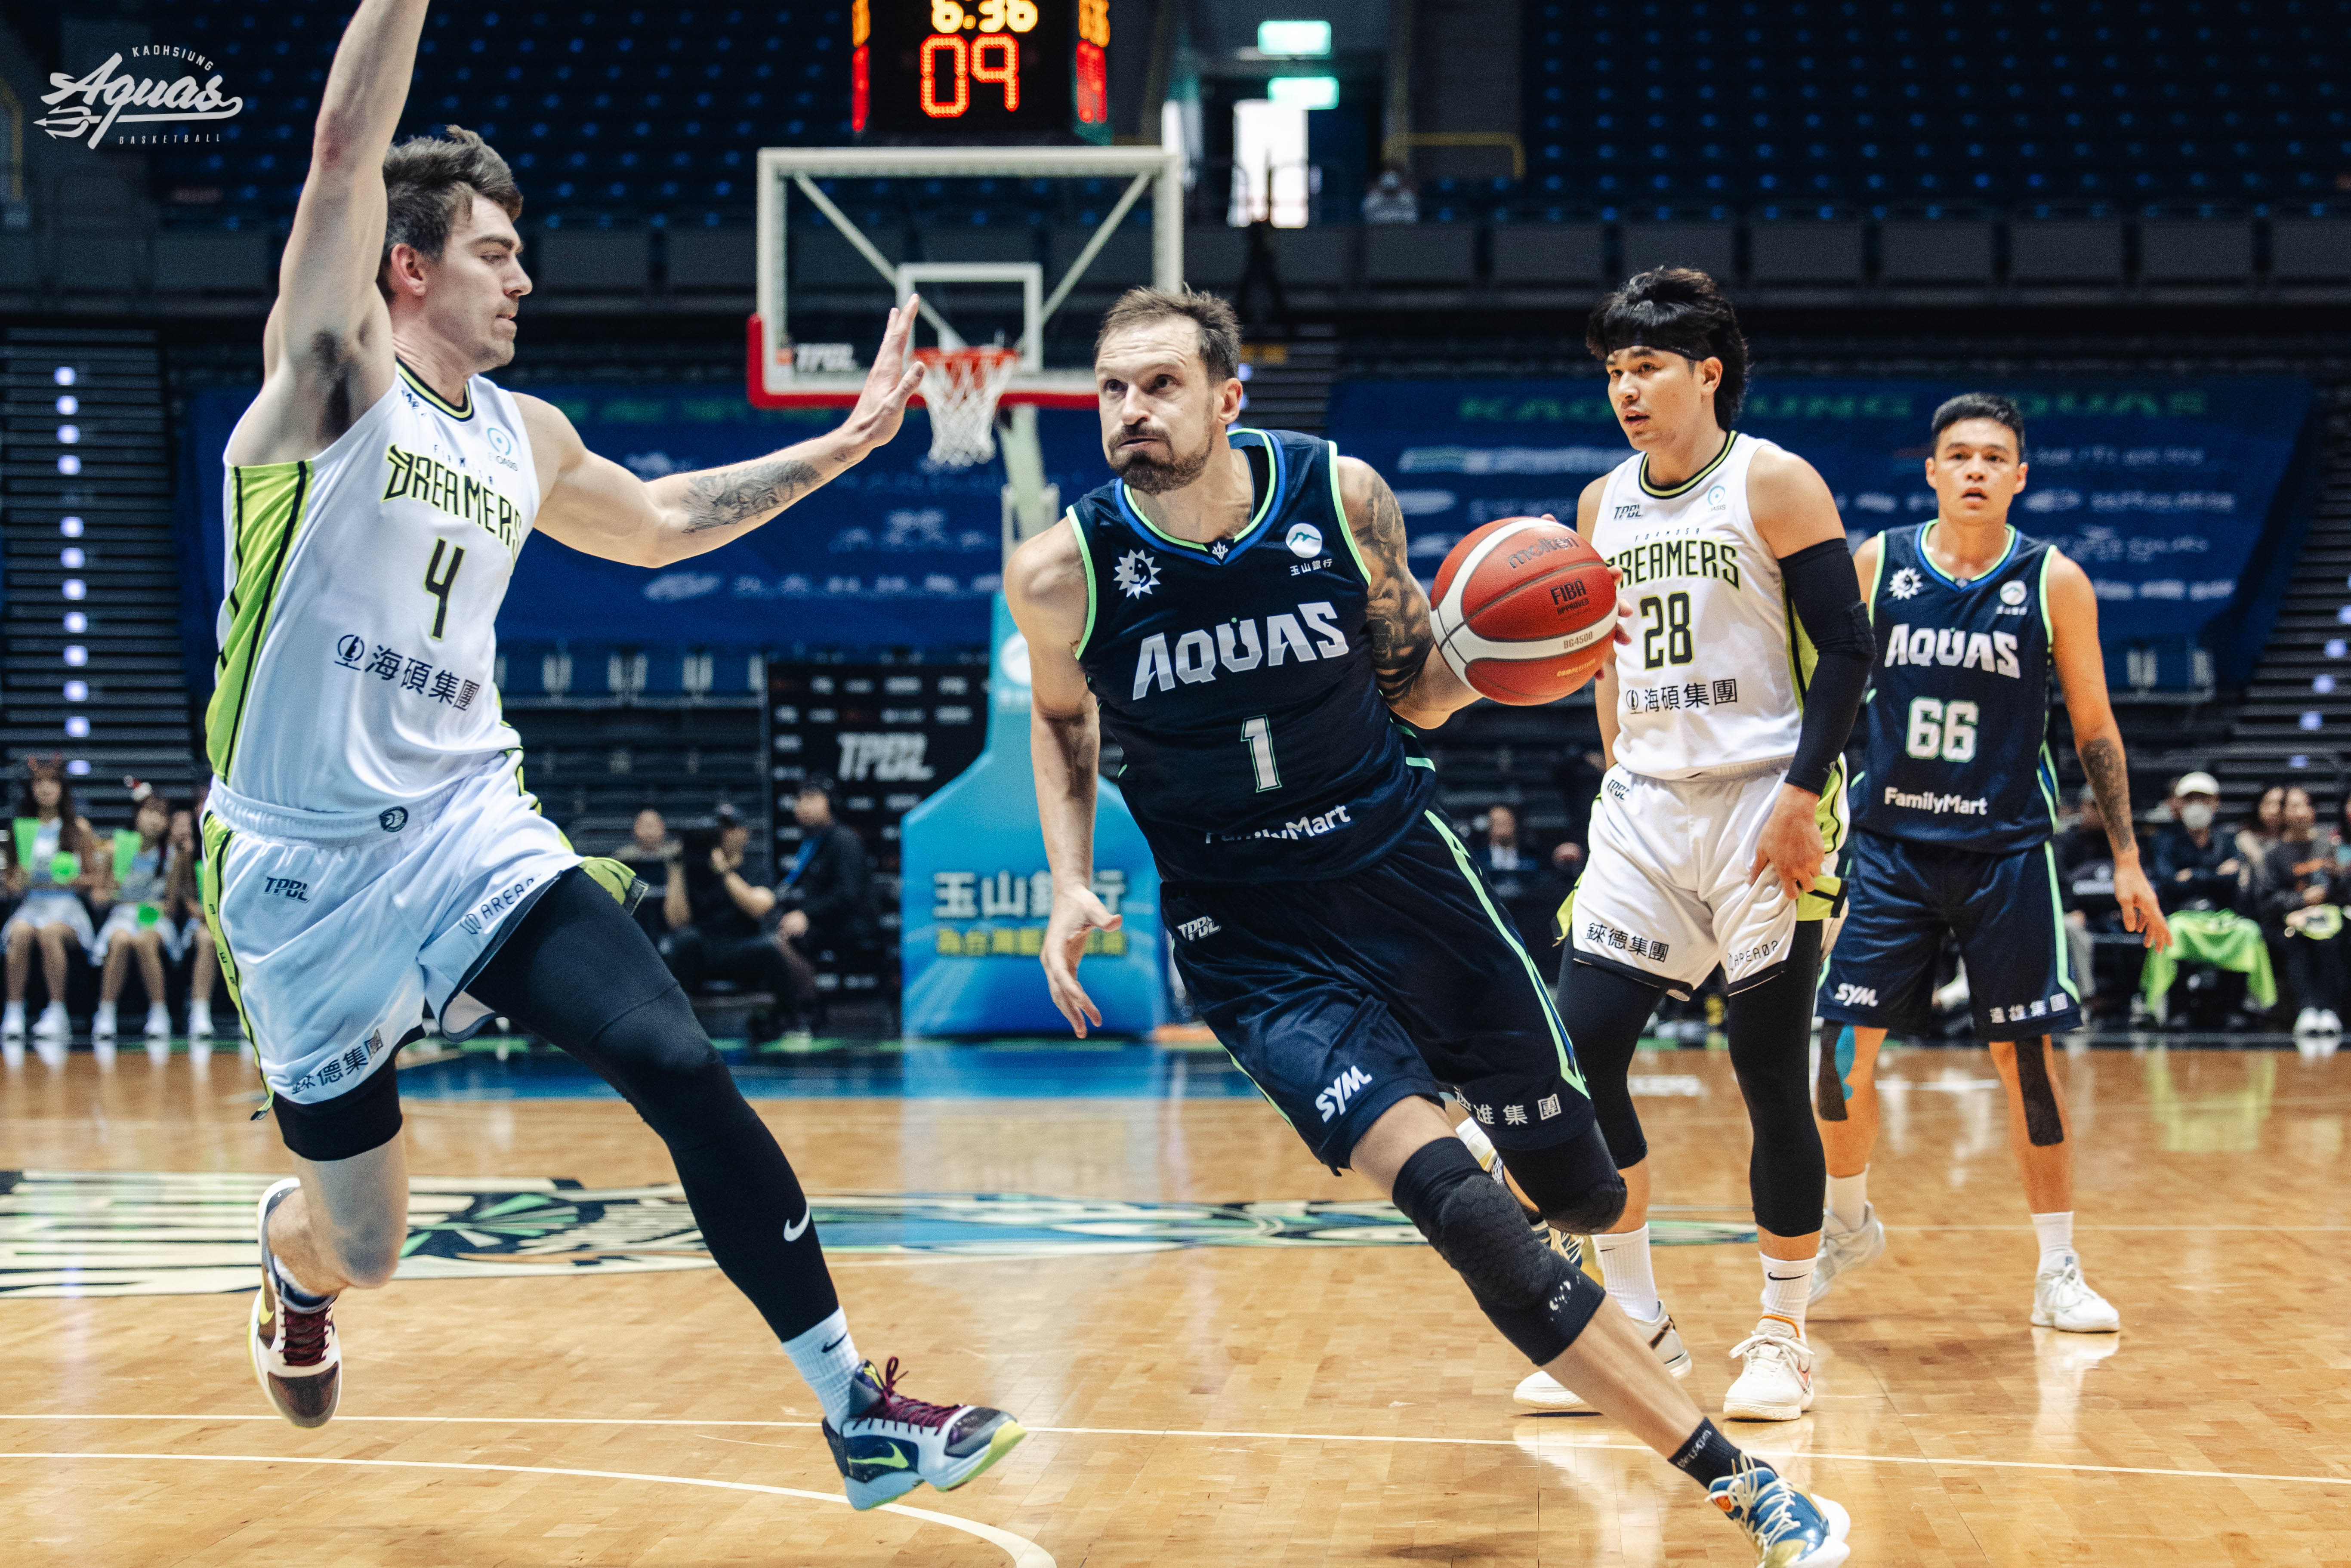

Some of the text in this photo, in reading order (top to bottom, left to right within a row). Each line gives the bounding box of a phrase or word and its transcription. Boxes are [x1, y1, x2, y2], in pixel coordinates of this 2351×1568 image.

[920, 33, 1019, 117] 09
[1614, 504, 1645, 520] TPBL
[1290, 559, 1333, 576] 玉山銀行
[1508, 537, 1579, 568] molten
[424, 536, 466, 642] 4
[1550, 579, 1587, 605] FIBA
[1557, 599, 1589, 615] APPROVED
[1563, 631, 1593, 649] BG4500
[1639, 591, 1695, 670] 28
[1133, 602, 1349, 701] AQUAS
[1884, 623, 2021, 679] AQUAS
[365, 645, 480, 711] 海碩集團
[1644, 679, 1737, 713] 海碩集團
[1906, 695, 1978, 763] 66
[1240, 714, 1282, 793] 1
[1884, 787, 1988, 815] FamilyMart
[264, 877, 310, 903] TPBL
[481, 874, 541, 920] AREA
[1177, 915, 1222, 941] TPBL
[1585, 922, 1669, 963] 錸德集團
[1834, 982, 1879, 1007] SYM
[1315, 1065, 1373, 1123] SYM
